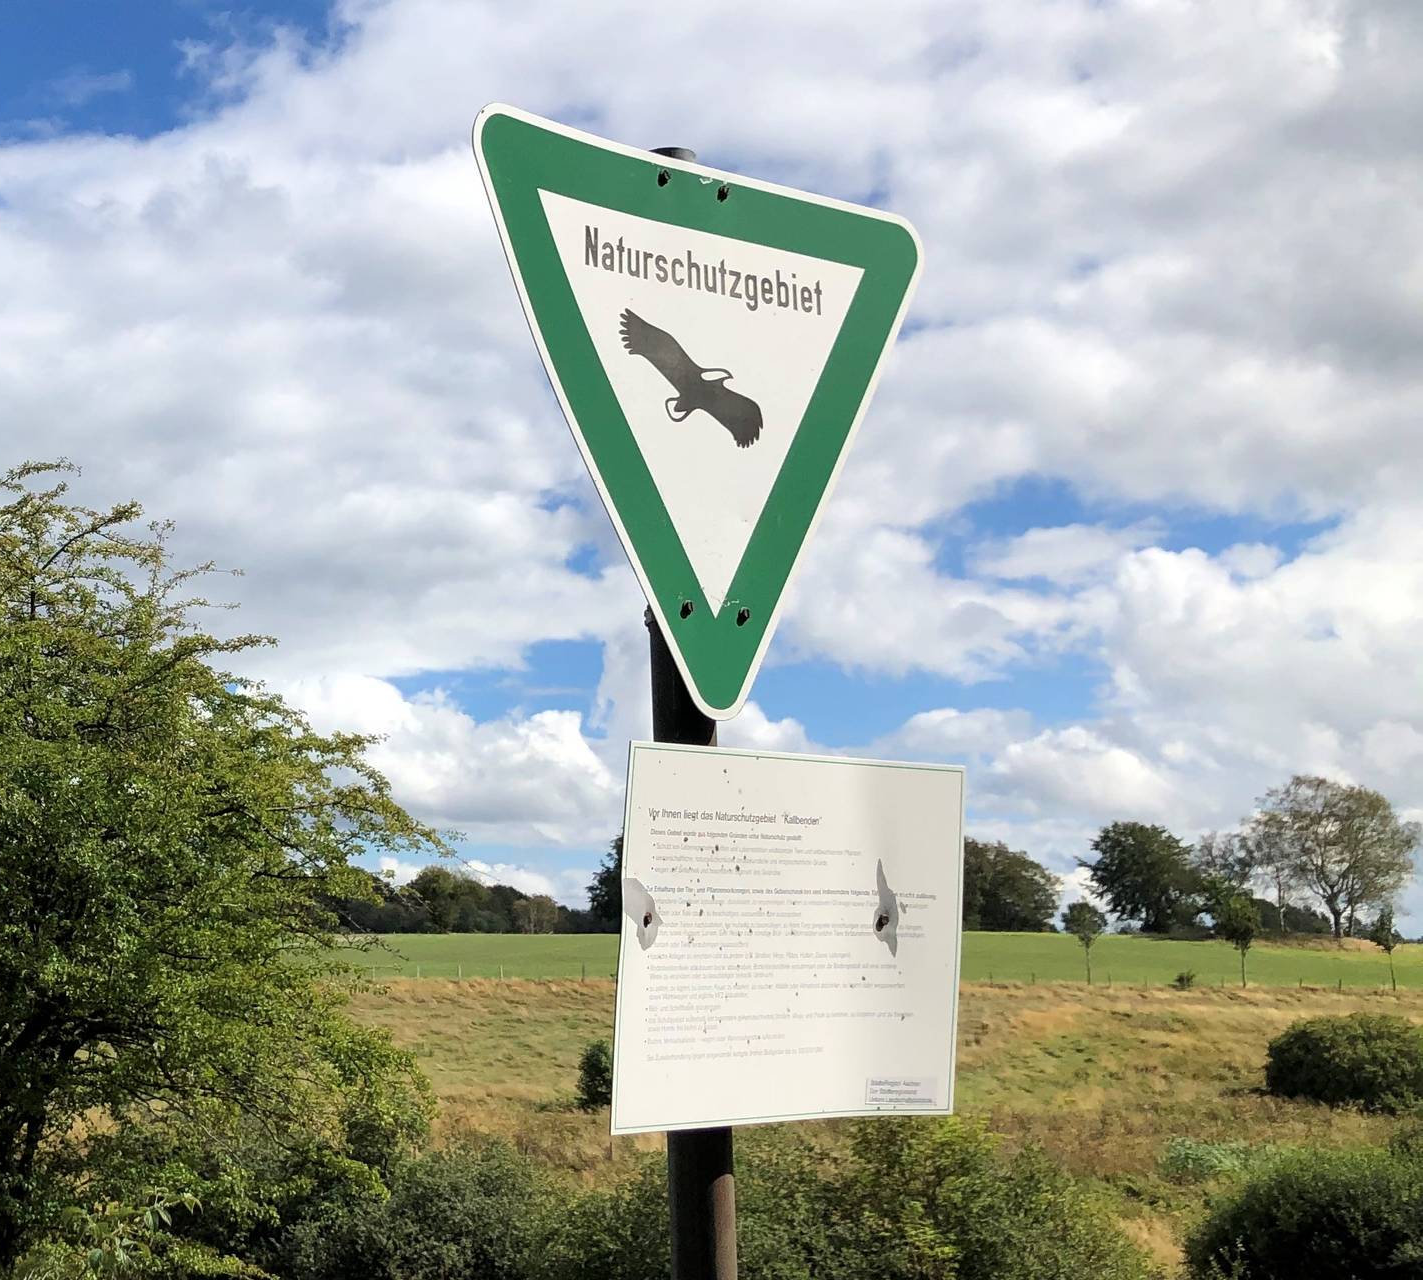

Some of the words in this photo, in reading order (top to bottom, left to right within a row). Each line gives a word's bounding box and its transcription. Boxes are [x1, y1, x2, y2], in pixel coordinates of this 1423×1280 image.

[584, 225, 823, 316] Naturschutzgebiet
[648, 807, 660, 818] Vor
[661, 808, 682, 819] Ihnen
[683, 809, 699, 821] liegt
[700, 810, 714, 821] das
[715, 811, 777, 825] Naturschutzgebiet
